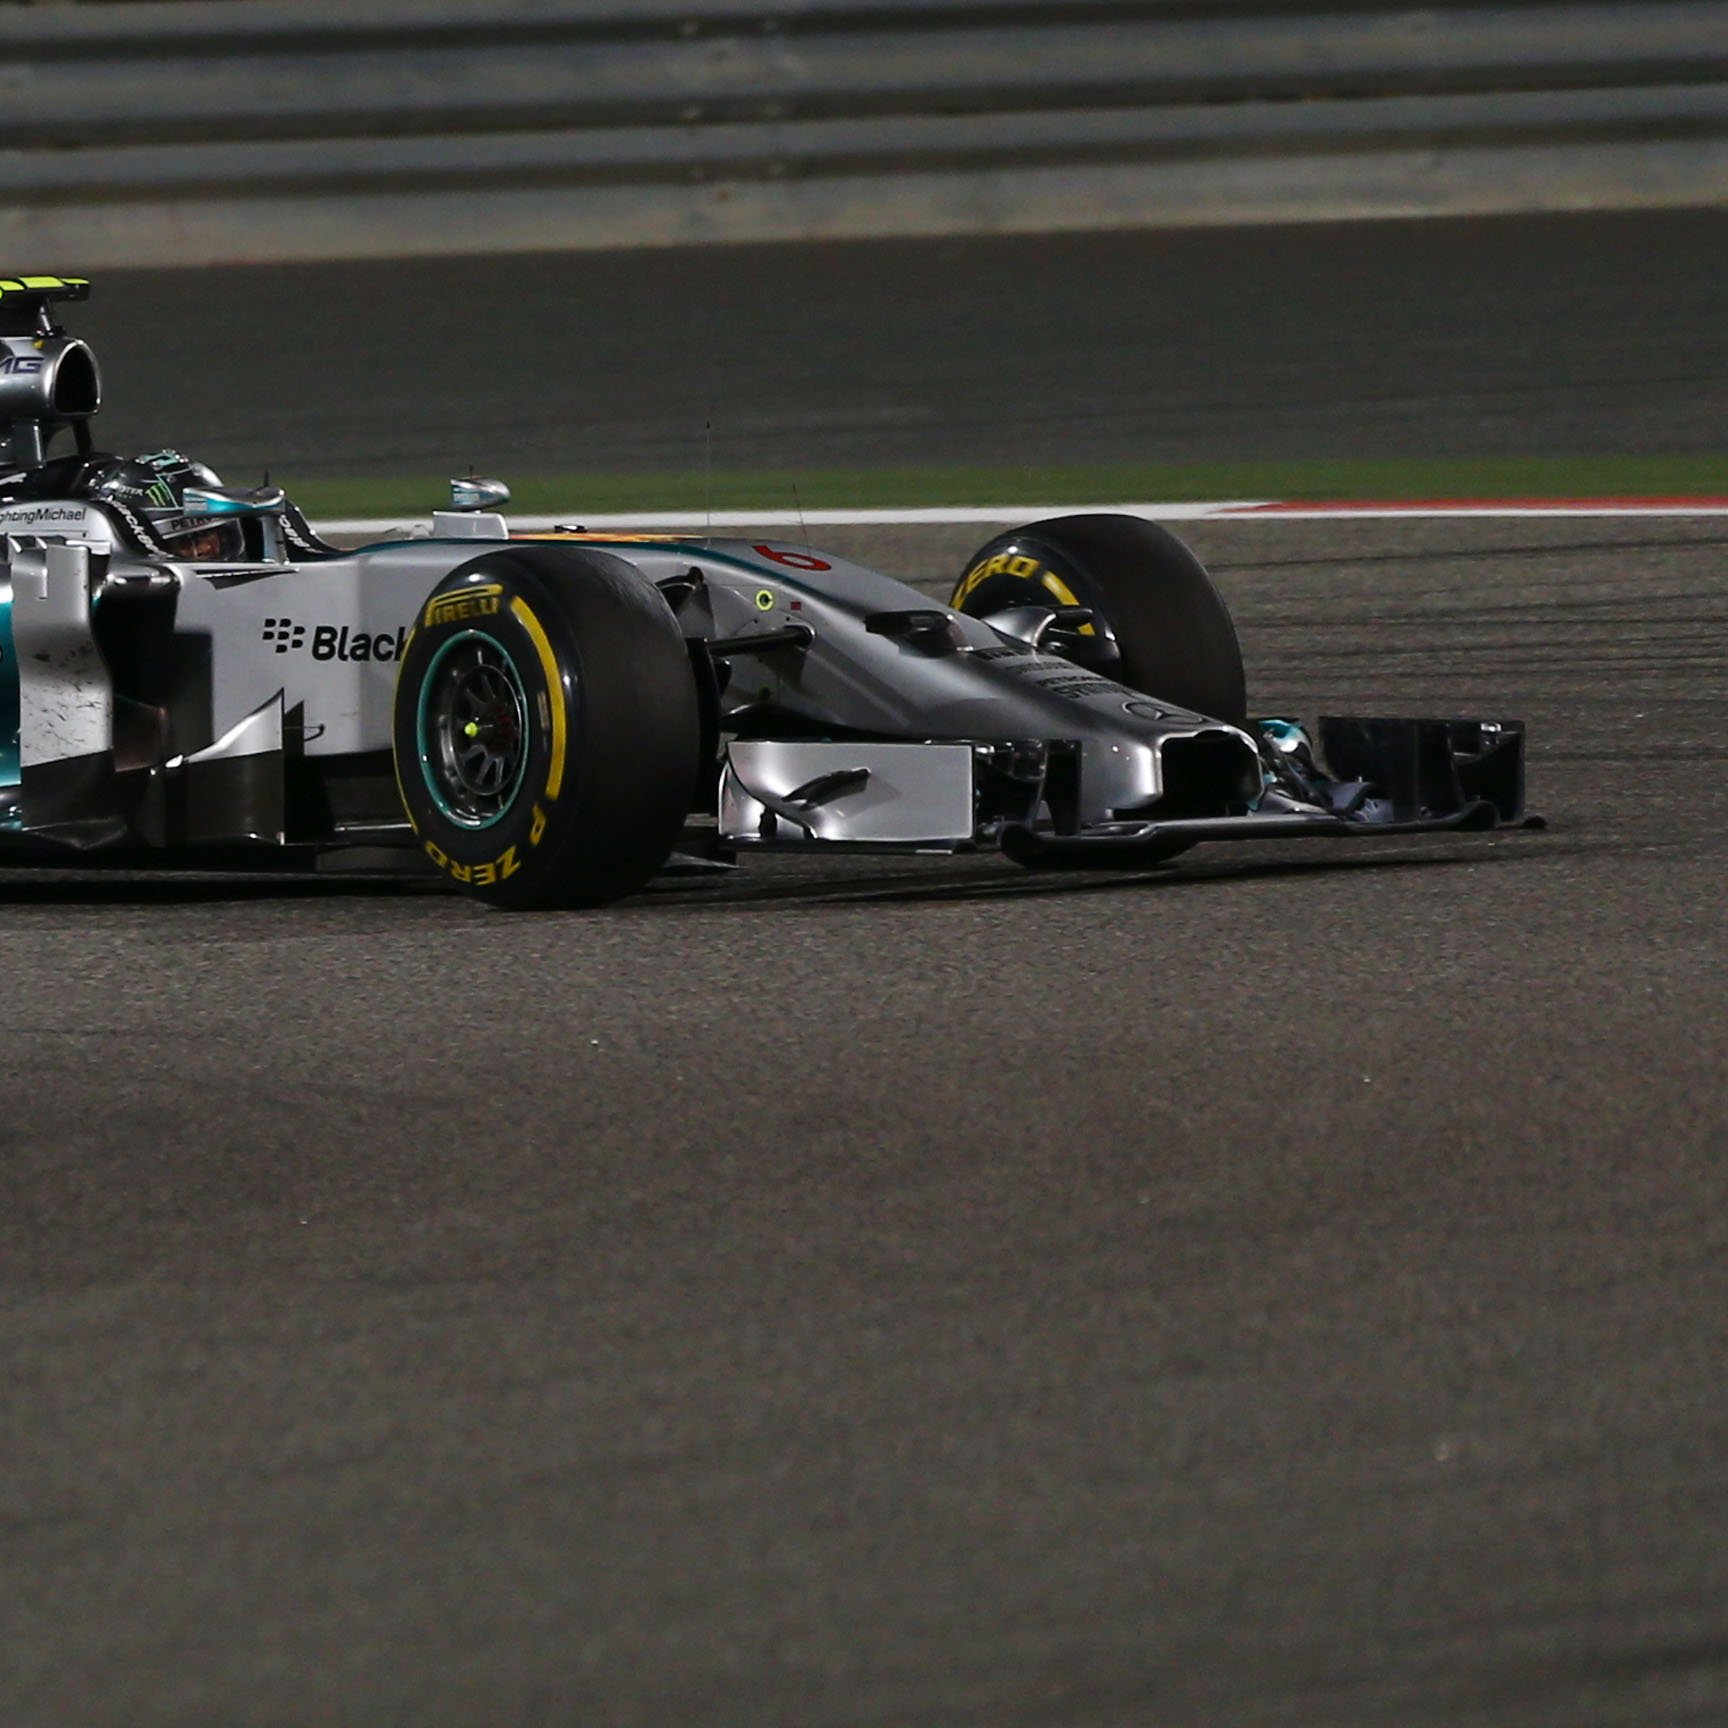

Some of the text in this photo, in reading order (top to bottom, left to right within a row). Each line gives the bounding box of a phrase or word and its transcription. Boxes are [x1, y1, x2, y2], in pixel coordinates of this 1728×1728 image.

[751, 544, 832, 571] 6
[424, 583, 504, 628] PIRELLI
[425, 839, 522, 887] ZERO
